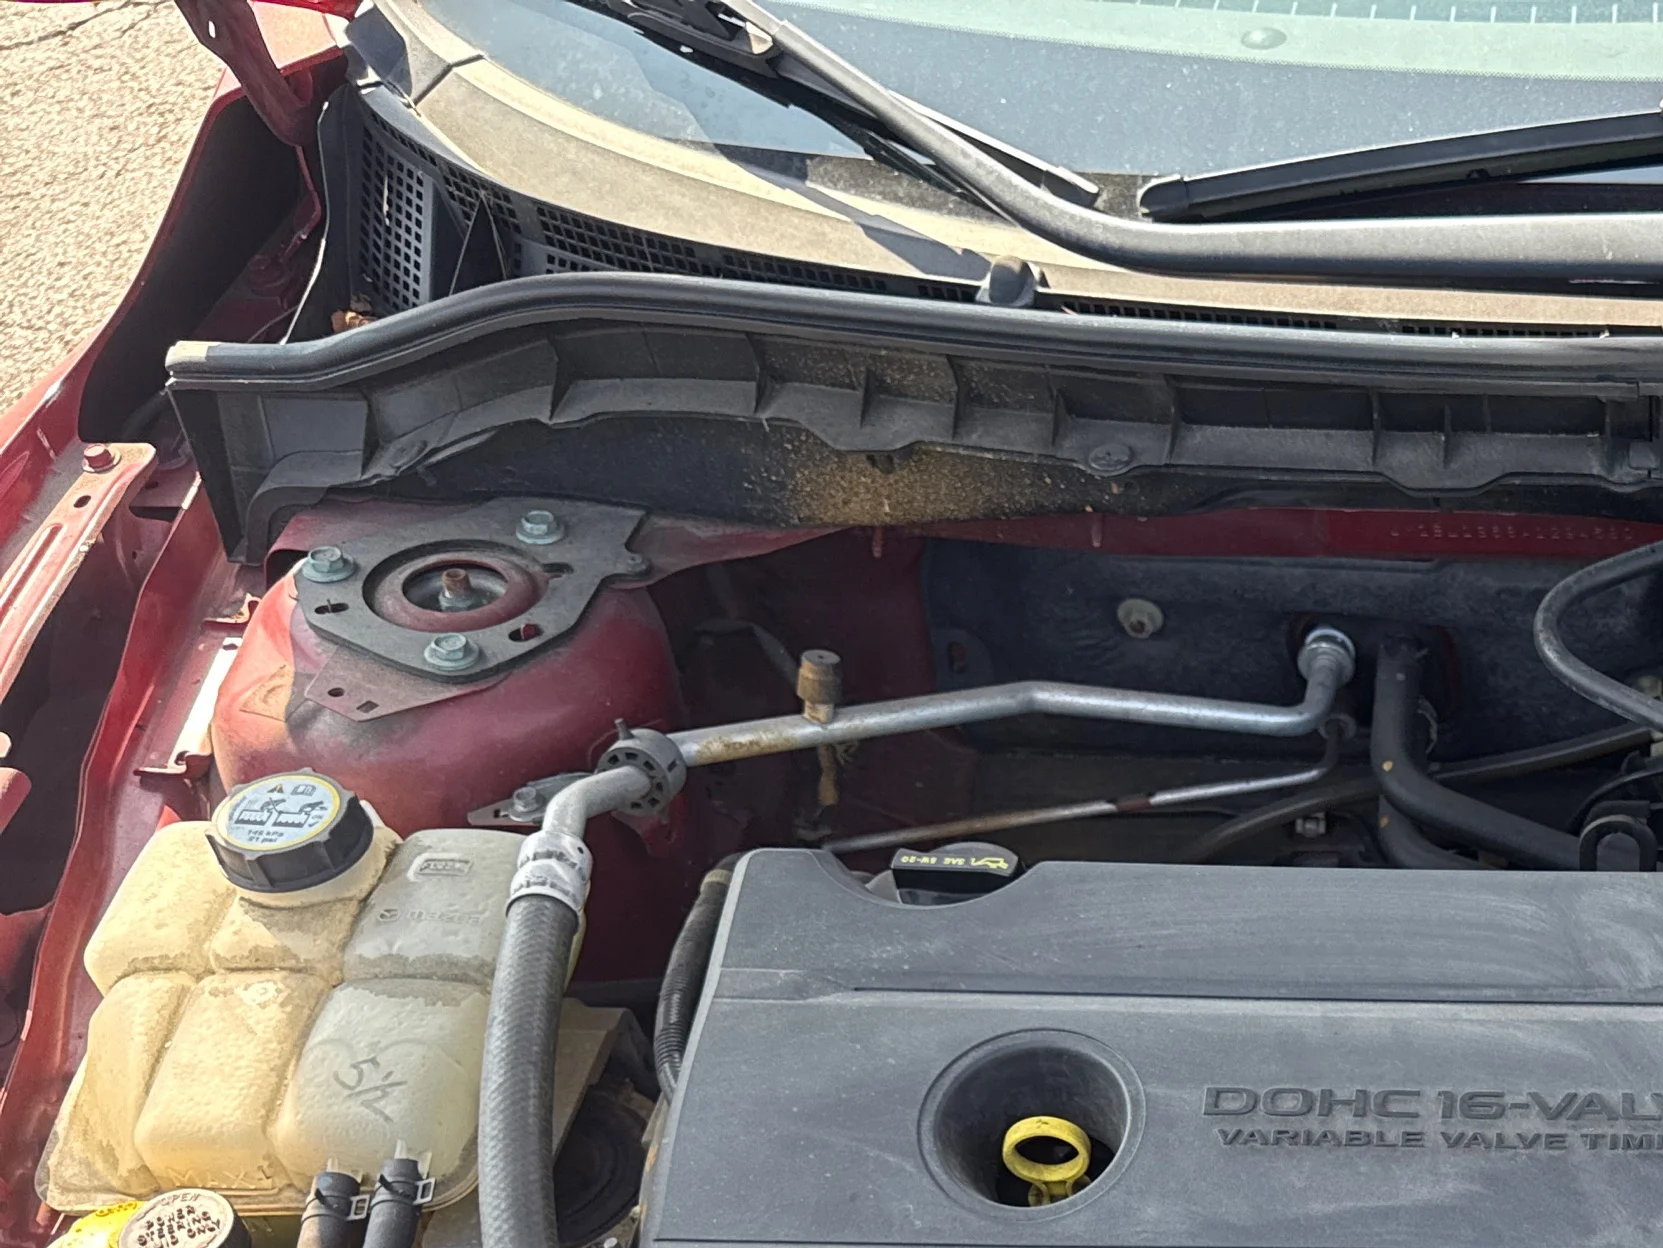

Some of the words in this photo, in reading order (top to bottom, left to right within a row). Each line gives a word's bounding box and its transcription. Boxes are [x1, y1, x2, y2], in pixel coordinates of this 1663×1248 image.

[261, 836, 278, 845] psi
[266, 829, 285, 838] kPa
[901, 856, 938, 864] 5W-20
[943, 857, 965, 865] SAE
[1203, 1085, 1421, 1119] DOHC
[1217, 1127, 1426, 1149] VARIABLE
[1440, 1131, 1568, 1150] VALVE
[160, 1192, 200, 1206] OPEN
[146, 1205, 196, 1231] POWER
[137, 1210, 212, 1247] STEERING
[187, 1218, 221, 1239] ONLY
